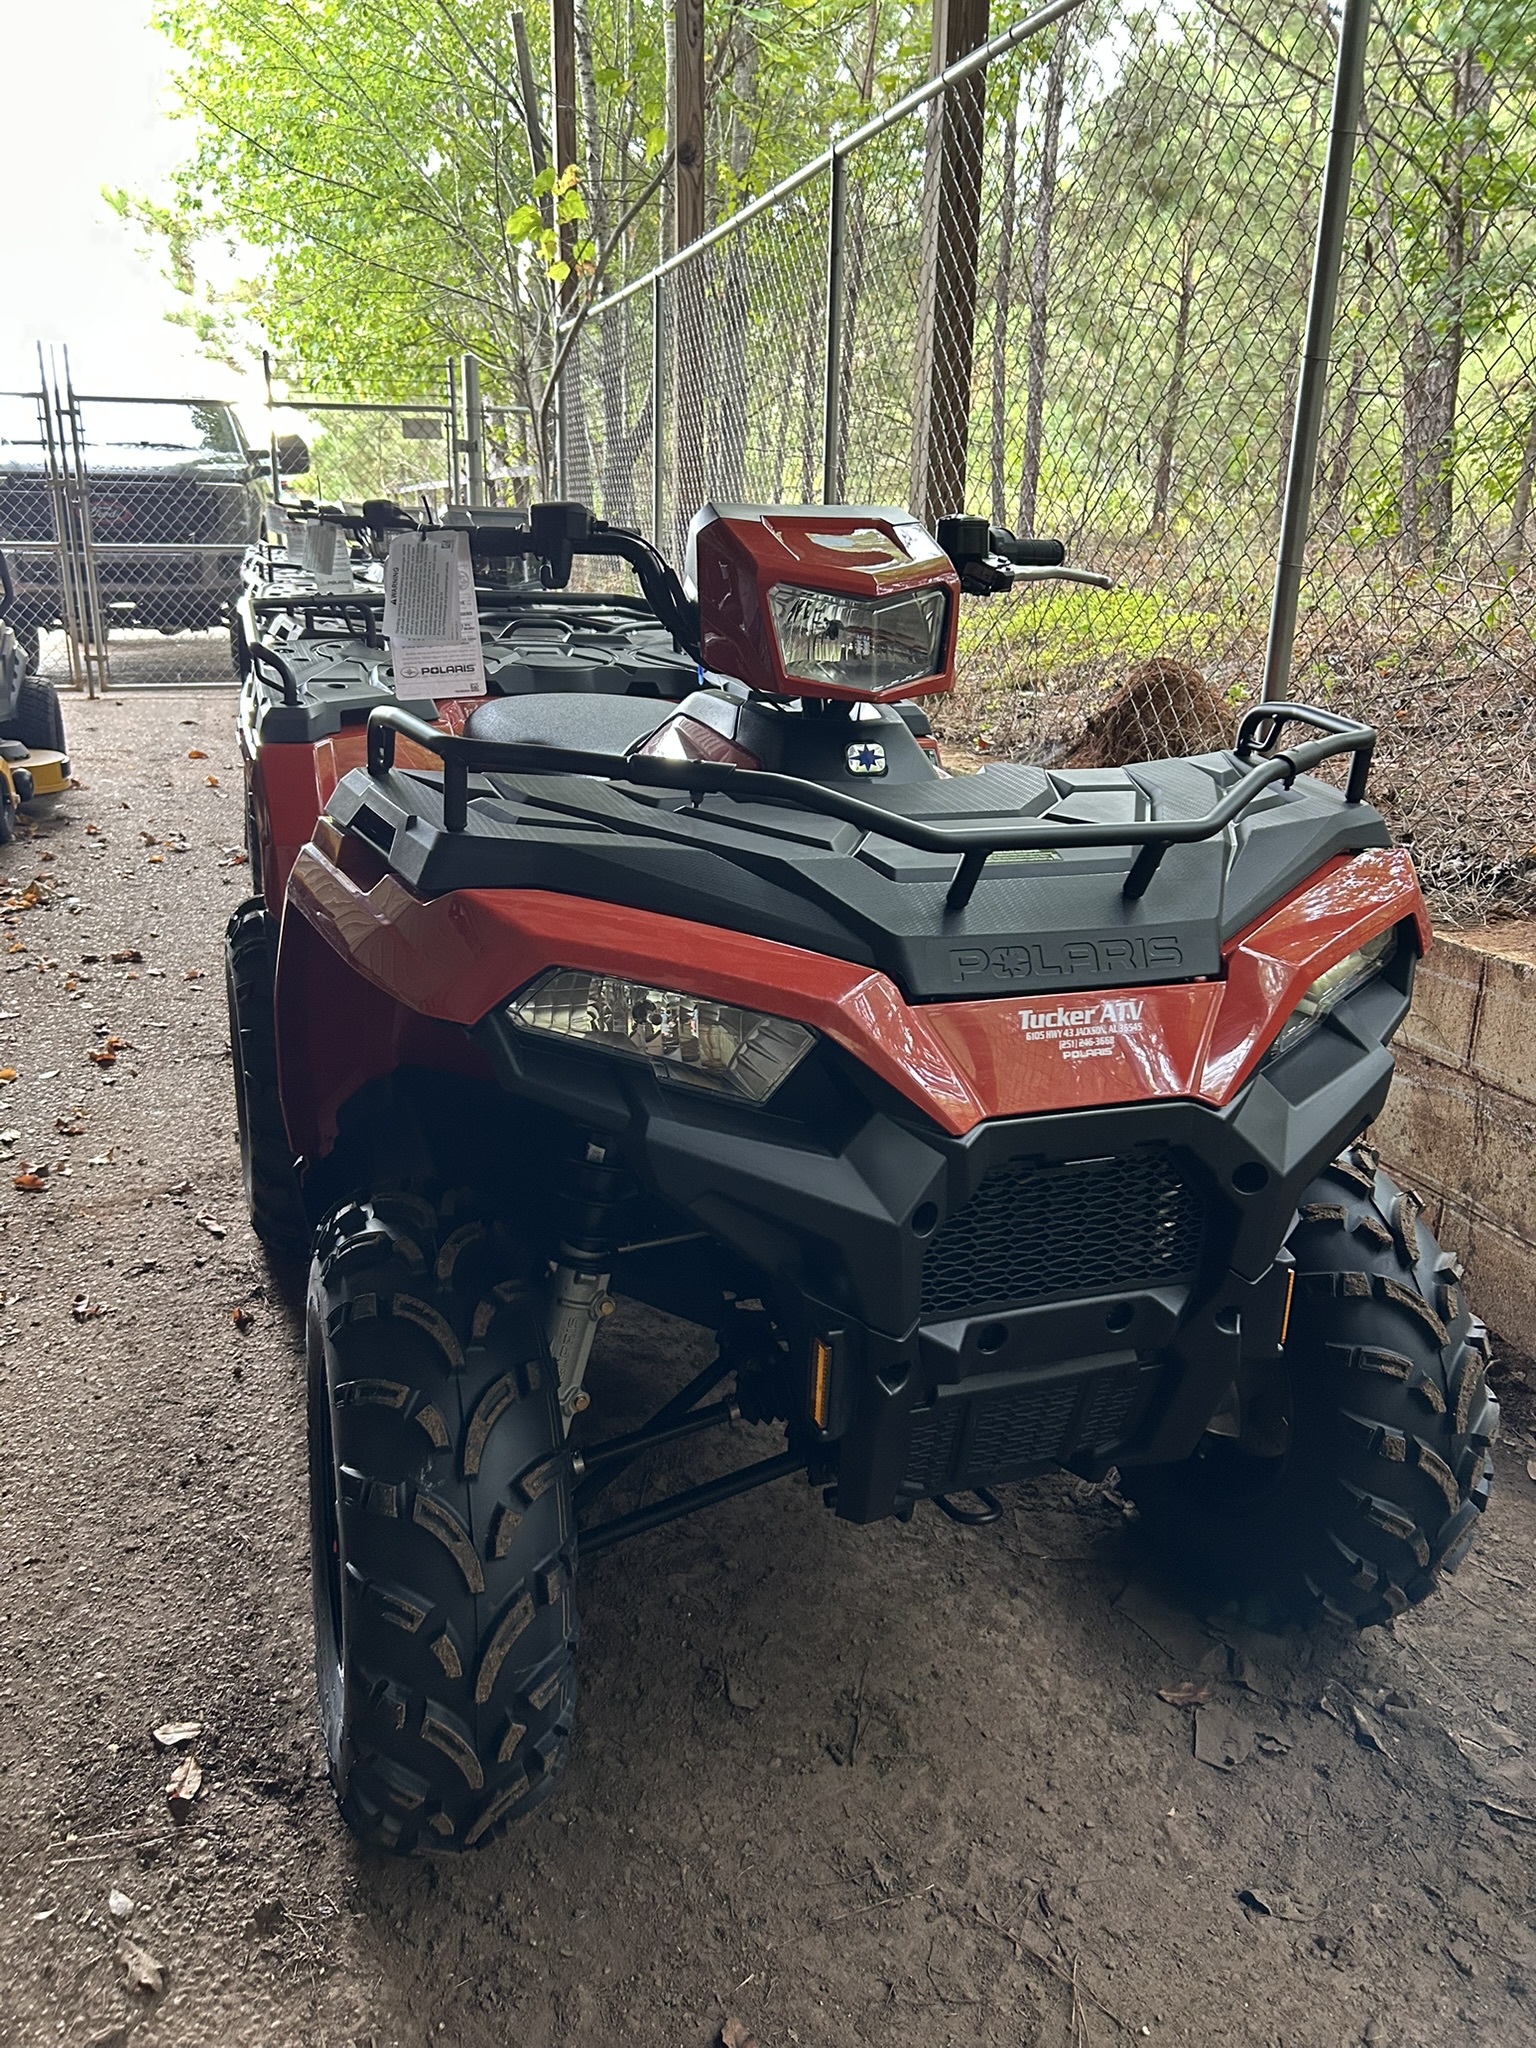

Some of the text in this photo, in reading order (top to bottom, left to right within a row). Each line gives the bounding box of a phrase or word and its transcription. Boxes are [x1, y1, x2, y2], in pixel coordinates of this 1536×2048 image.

[392, 567, 400, 599] WARNING
[421, 664, 475, 675] POLARIS
[949, 936, 1183, 982] POLARIS
[1018, 1000, 1144, 1030] Tucker ATV
[1025, 1031, 1045, 1041] 6105
[1045, 1029, 1062, 1039] HWY
[1063, 1028, 1074, 1038] 43
[1108, 1023, 1118, 1033] AL
[1058, 1039, 1078, 1051] (251)
[1062, 1048, 1113, 1060] POLARIS
